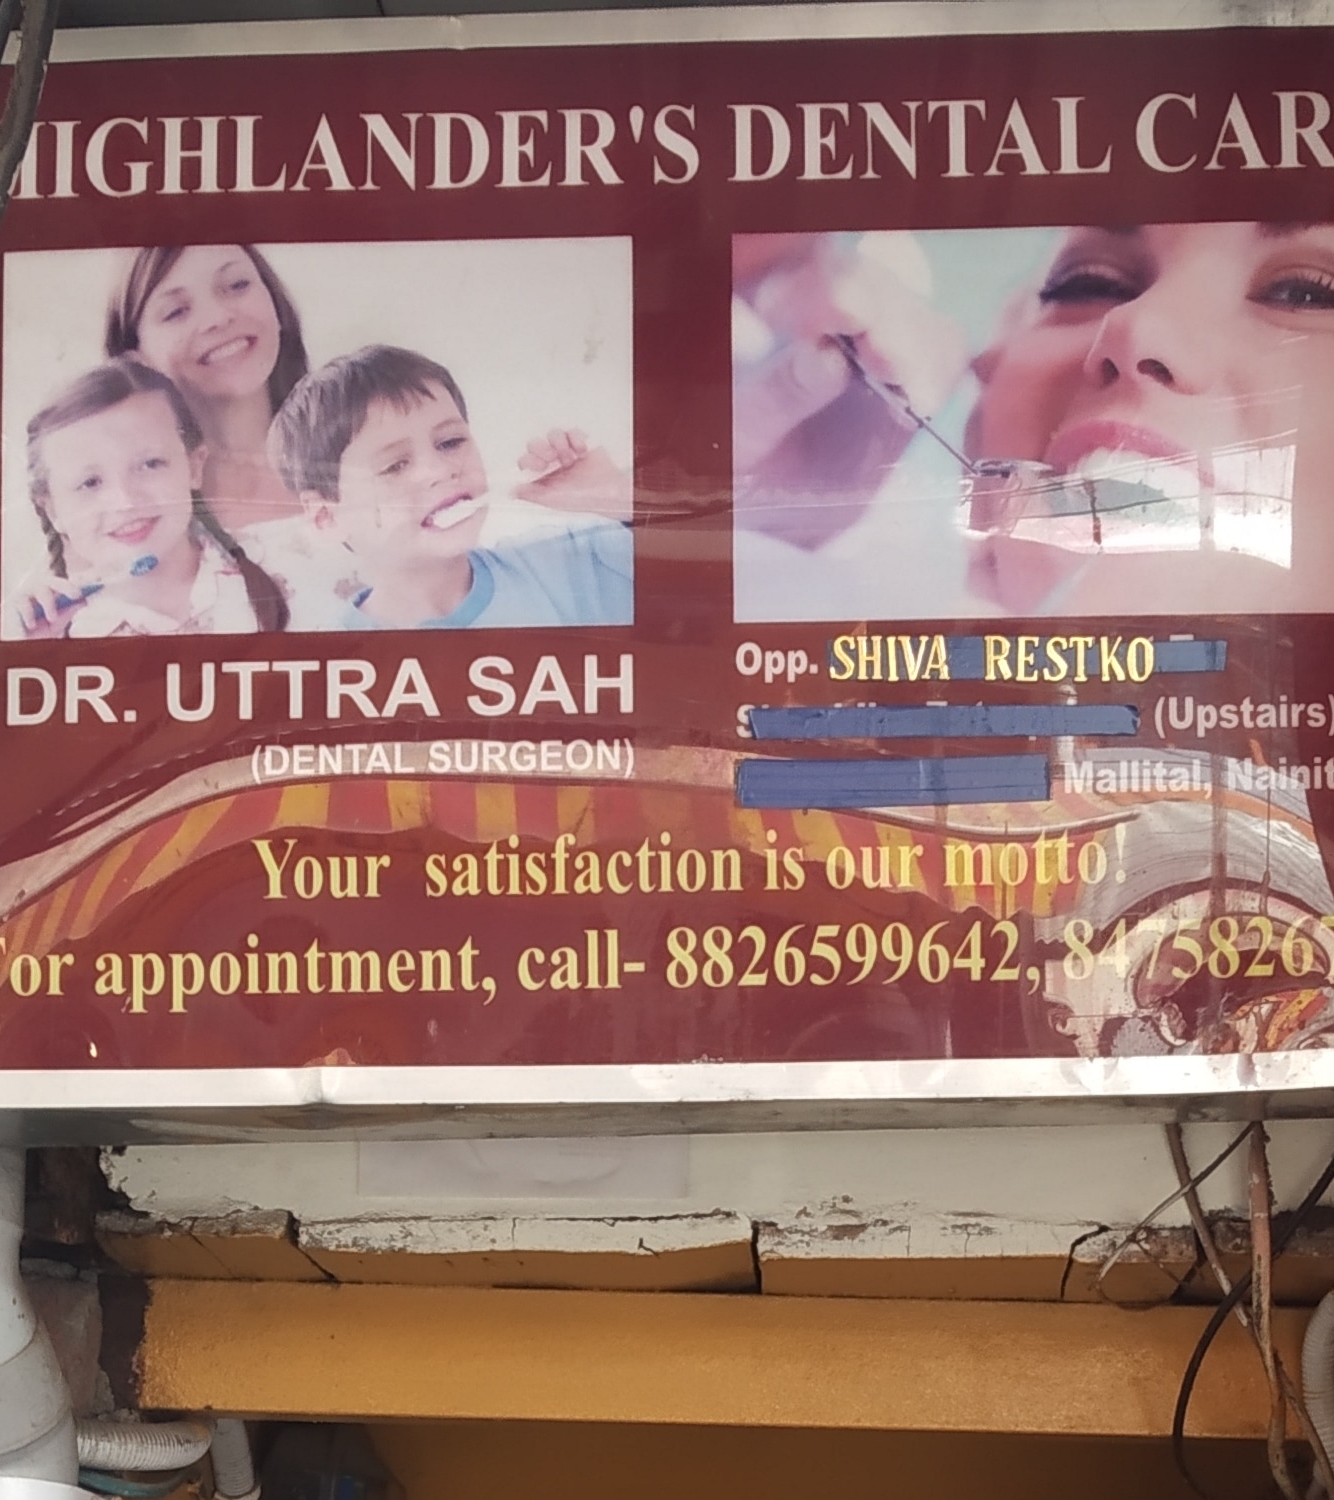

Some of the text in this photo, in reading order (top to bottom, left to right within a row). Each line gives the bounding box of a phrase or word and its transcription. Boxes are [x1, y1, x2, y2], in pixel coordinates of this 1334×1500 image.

[727, 96, 1113, 183] DENTAL
[4, 654, 636, 725] DR. UTTRA SAH
[736, 635, 1154, 683] Opp. SHIVA RESTKO
[251, 736, 636, 784] (DENTAL SURGEON)
[1063, 756, 1211, 799] Mallital,
[252, 824, 1129, 899] Your satisfaction is our motto!
[94, 934, 499, 1012] appointment,
[517, 929, 647, 991] call-
[665, 924, 1041, 995] 8826599642,
